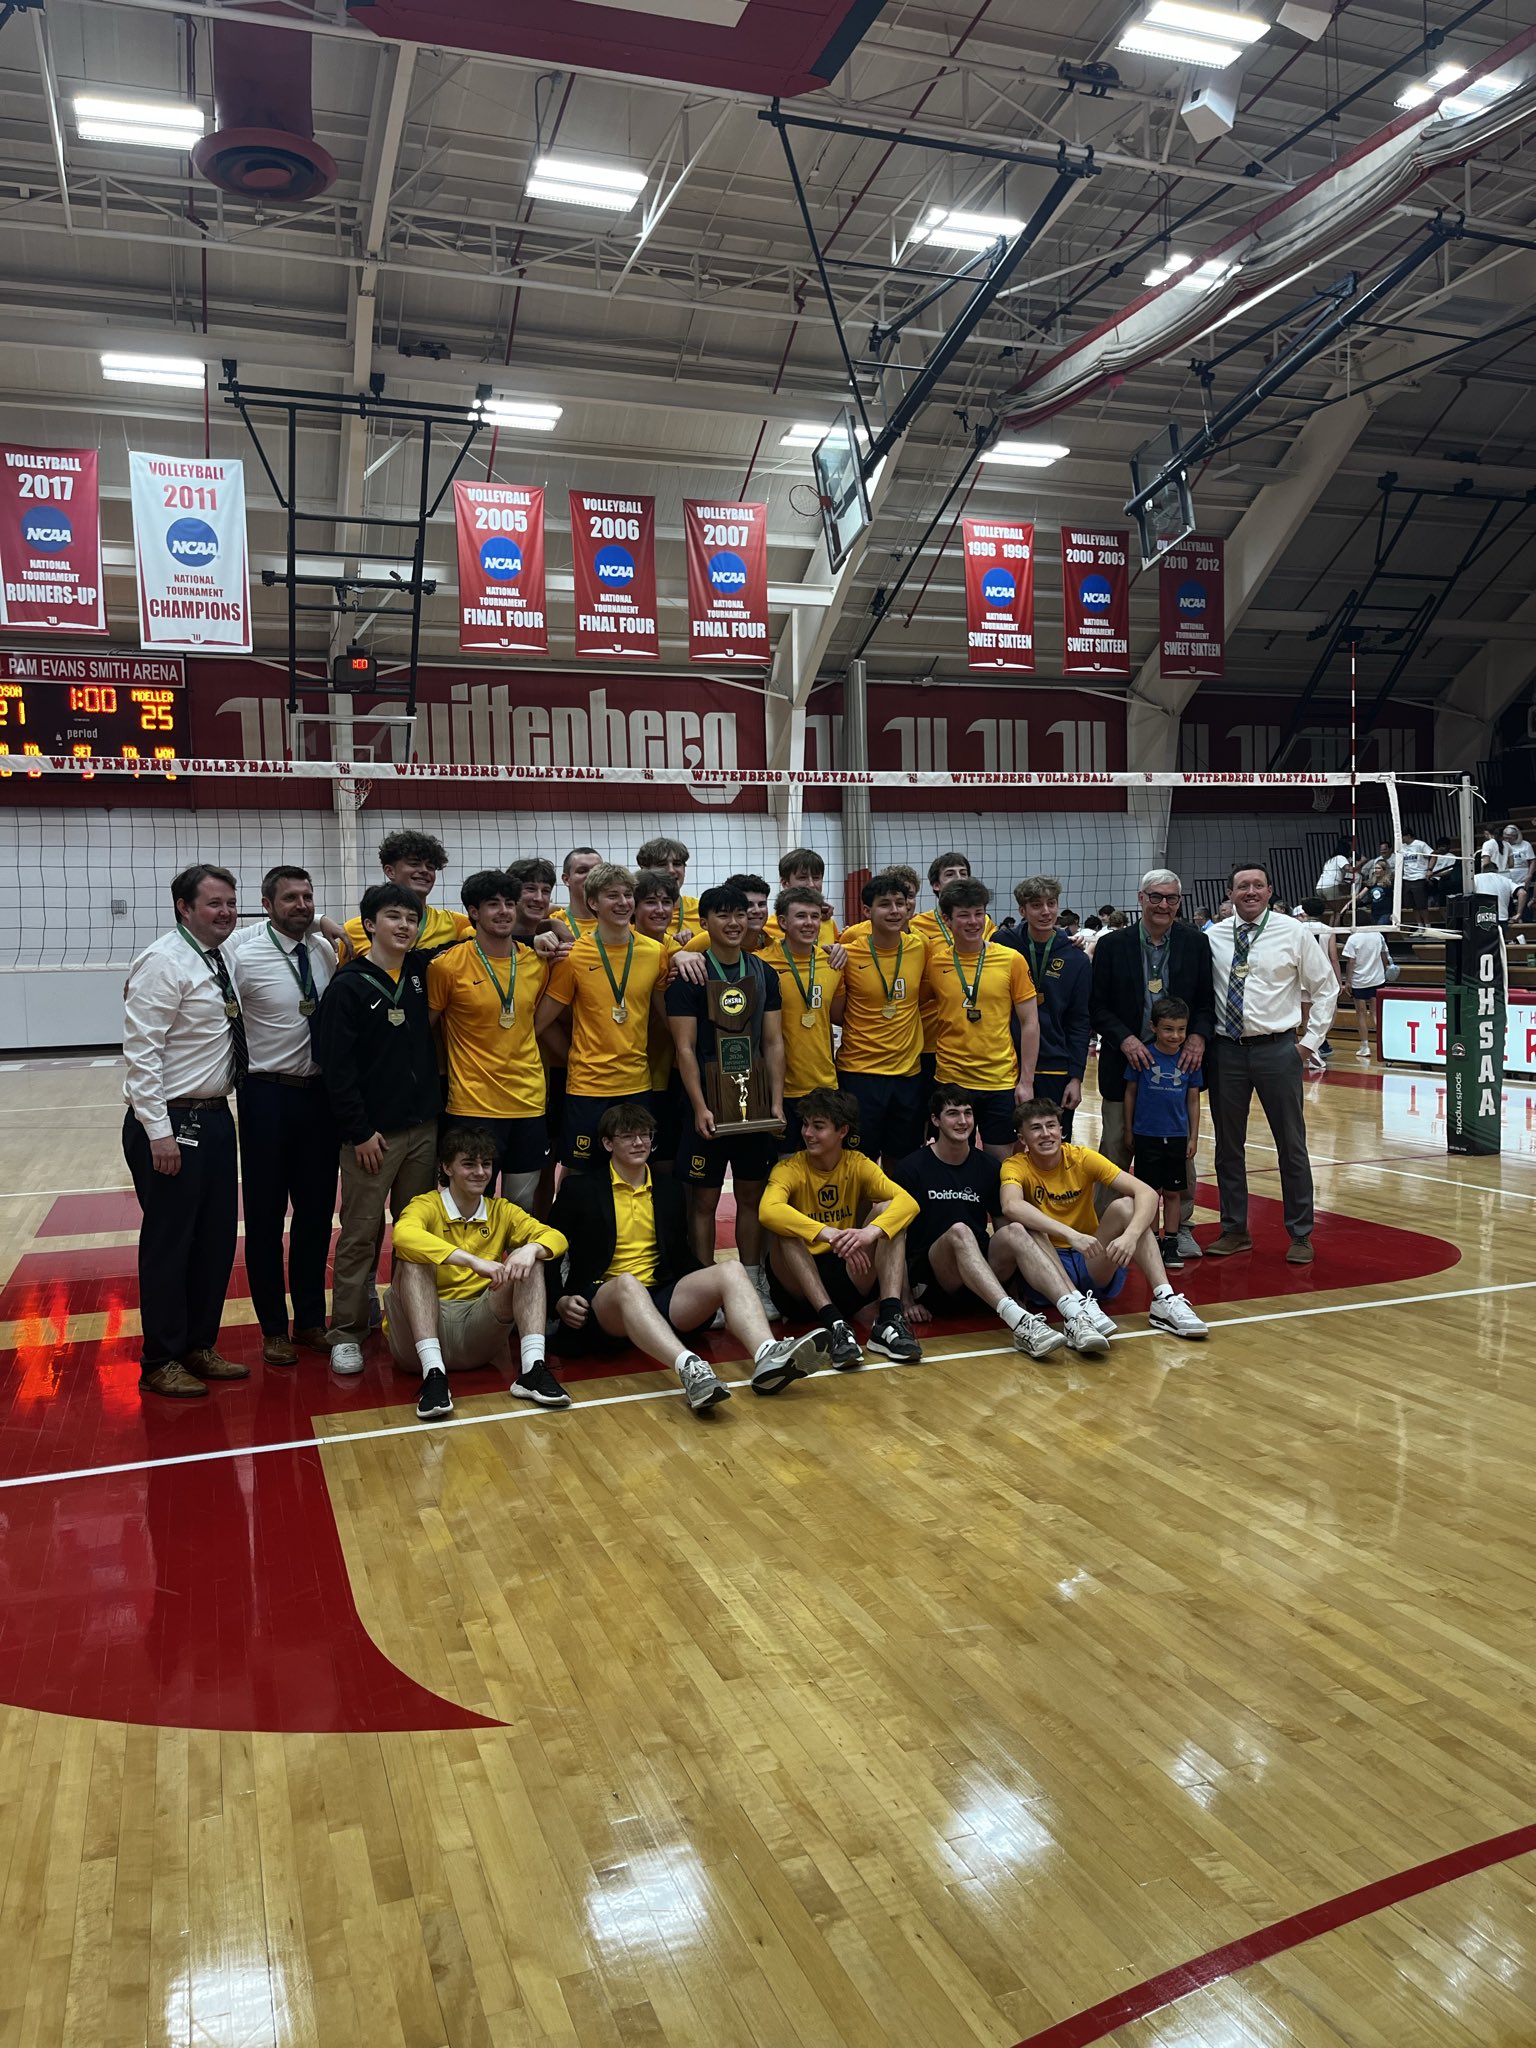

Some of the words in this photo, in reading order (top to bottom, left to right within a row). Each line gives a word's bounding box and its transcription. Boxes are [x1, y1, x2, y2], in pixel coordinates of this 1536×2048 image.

[5, 453, 82, 471] VOLLEYBALL
[149, 462, 225, 480] VOLLEYBALL
[18, 473, 73, 500] 2017
[163, 484, 217, 510] 2011
[467, 488, 531, 505] VOLLEYBALL
[583, 498, 643, 514] VOLLEYBALL
[696, 506, 755, 521] VOLLEYBALL
[475, 507, 528, 532] 2005
[27, 528, 71, 543] NCAA
[590, 516, 639, 540] 2006
[703, 524, 749, 547] 2007
[973, 525, 1024, 540] VOLLEYBALL
[172, 540, 216, 555] NCAA
[1071, 533, 1119, 547] VOLLEYBALL
[968, 541, 996, 557] 1996
[30, 559, 71, 570] NATIONAL
[484, 557, 521, 570] NCAA
[1066, 549, 1094, 563] 2000
[1098, 551, 1125, 565] 2003
[1164, 555, 1188, 569] 2010
[1196, 557, 1219, 571] 2012
[22, 571, 80, 583] TOURNAMENT
[174, 574, 215, 584] NATIONAL
[598, 565, 634, 578] NCAA
[712, 572, 745, 583] NCAA
[6, 583, 97, 605] RUNNERS-UP
[166, 586, 223, 597] TOURNAMENT
[486, 586, 520, 596] NATIONAL
[600, 593, 632, 603] NATIONAL
[985, 586, 1015, 598] NCAA
[1083, 592, 1111, 604] NCAA
[479, 597, 527, 607] TOURNAMENT
[594, 604, 639, 614] TOURNAMENT
[713, 600, 744, 609] NATIONAL
[1180, 598, 1206, 608] NCAA
[150, 599, 241, 621] CHAMPIONS
[707, 609, 751, 619] TOURNAMENT
[986, 613, 1013, 621] NATIONAL
[463, 608, 503, 626] FINAL
[506, 611, 544, 628] FOUR
[579, 615, 617, 633] FINAL
[620, 617, 655, 634] FOUR
[1083, 618, 1109, 626] NATIONAL
[693, 621, 729, 637] FINAL
[732, 622, 766, 638] FOUR
[981, 622, 1019, 631] TOURNAMENT
[1079, 627, 1115, 636] TOURNAMENT
[1180, 622, 1204, 630] NATIONAL
[968, 632, 997, 648] SWEET
[998, 634, 1032, 649] SIXTEEN
[1176, 631, 1209, 639] TOURNAMENT
[1067, 637, 1094, 652] SWEET
[1095, 638, 1127, 653] SIXTEEN
[1164, 641, 1190, 656] SWEET
[1191, 642, 1221, 657] SIXTEEN
[9, 658, 37, 675] PAM
[42, 659, 86, 677] EVANS
[89, 661, 130, 679] SMITH
[133, 663, 178, 681] ARENA
[71, 687, 117, 713] 1:00
[132, 690, 174, 703] MOELLER
[141, 704, 174, 731] 25
[67, 728, 98, 739] period
[73, 744, 92, 757] SET
[50, 757, 172, 771] WITTENBERG
[180, 759, 293, 773] VOLLEYBALL
[394, 764, 499, 777] WITTENBERG
[505, 766, 604, 779] VOLLEYBALL
[691, 770, 782, 782] WITTENBERG
[788, 772, 873, 783] VOLLEYBALL
[951, 773, 1032, 783] WITTENBERG
[1037, 773, 1113, 783] VOLLEYBALL
[1182, 773, 1254, 783] WITTENBERG
[1258, 773, 1327, 783] VOLLEYBALL
[894, 978, 906, 1000] 9
[811, 985, 822, 1009] 8
[1478, 954, 1496, 1117] OHSAA
[1455, 1101, 1463, 1135] imports
